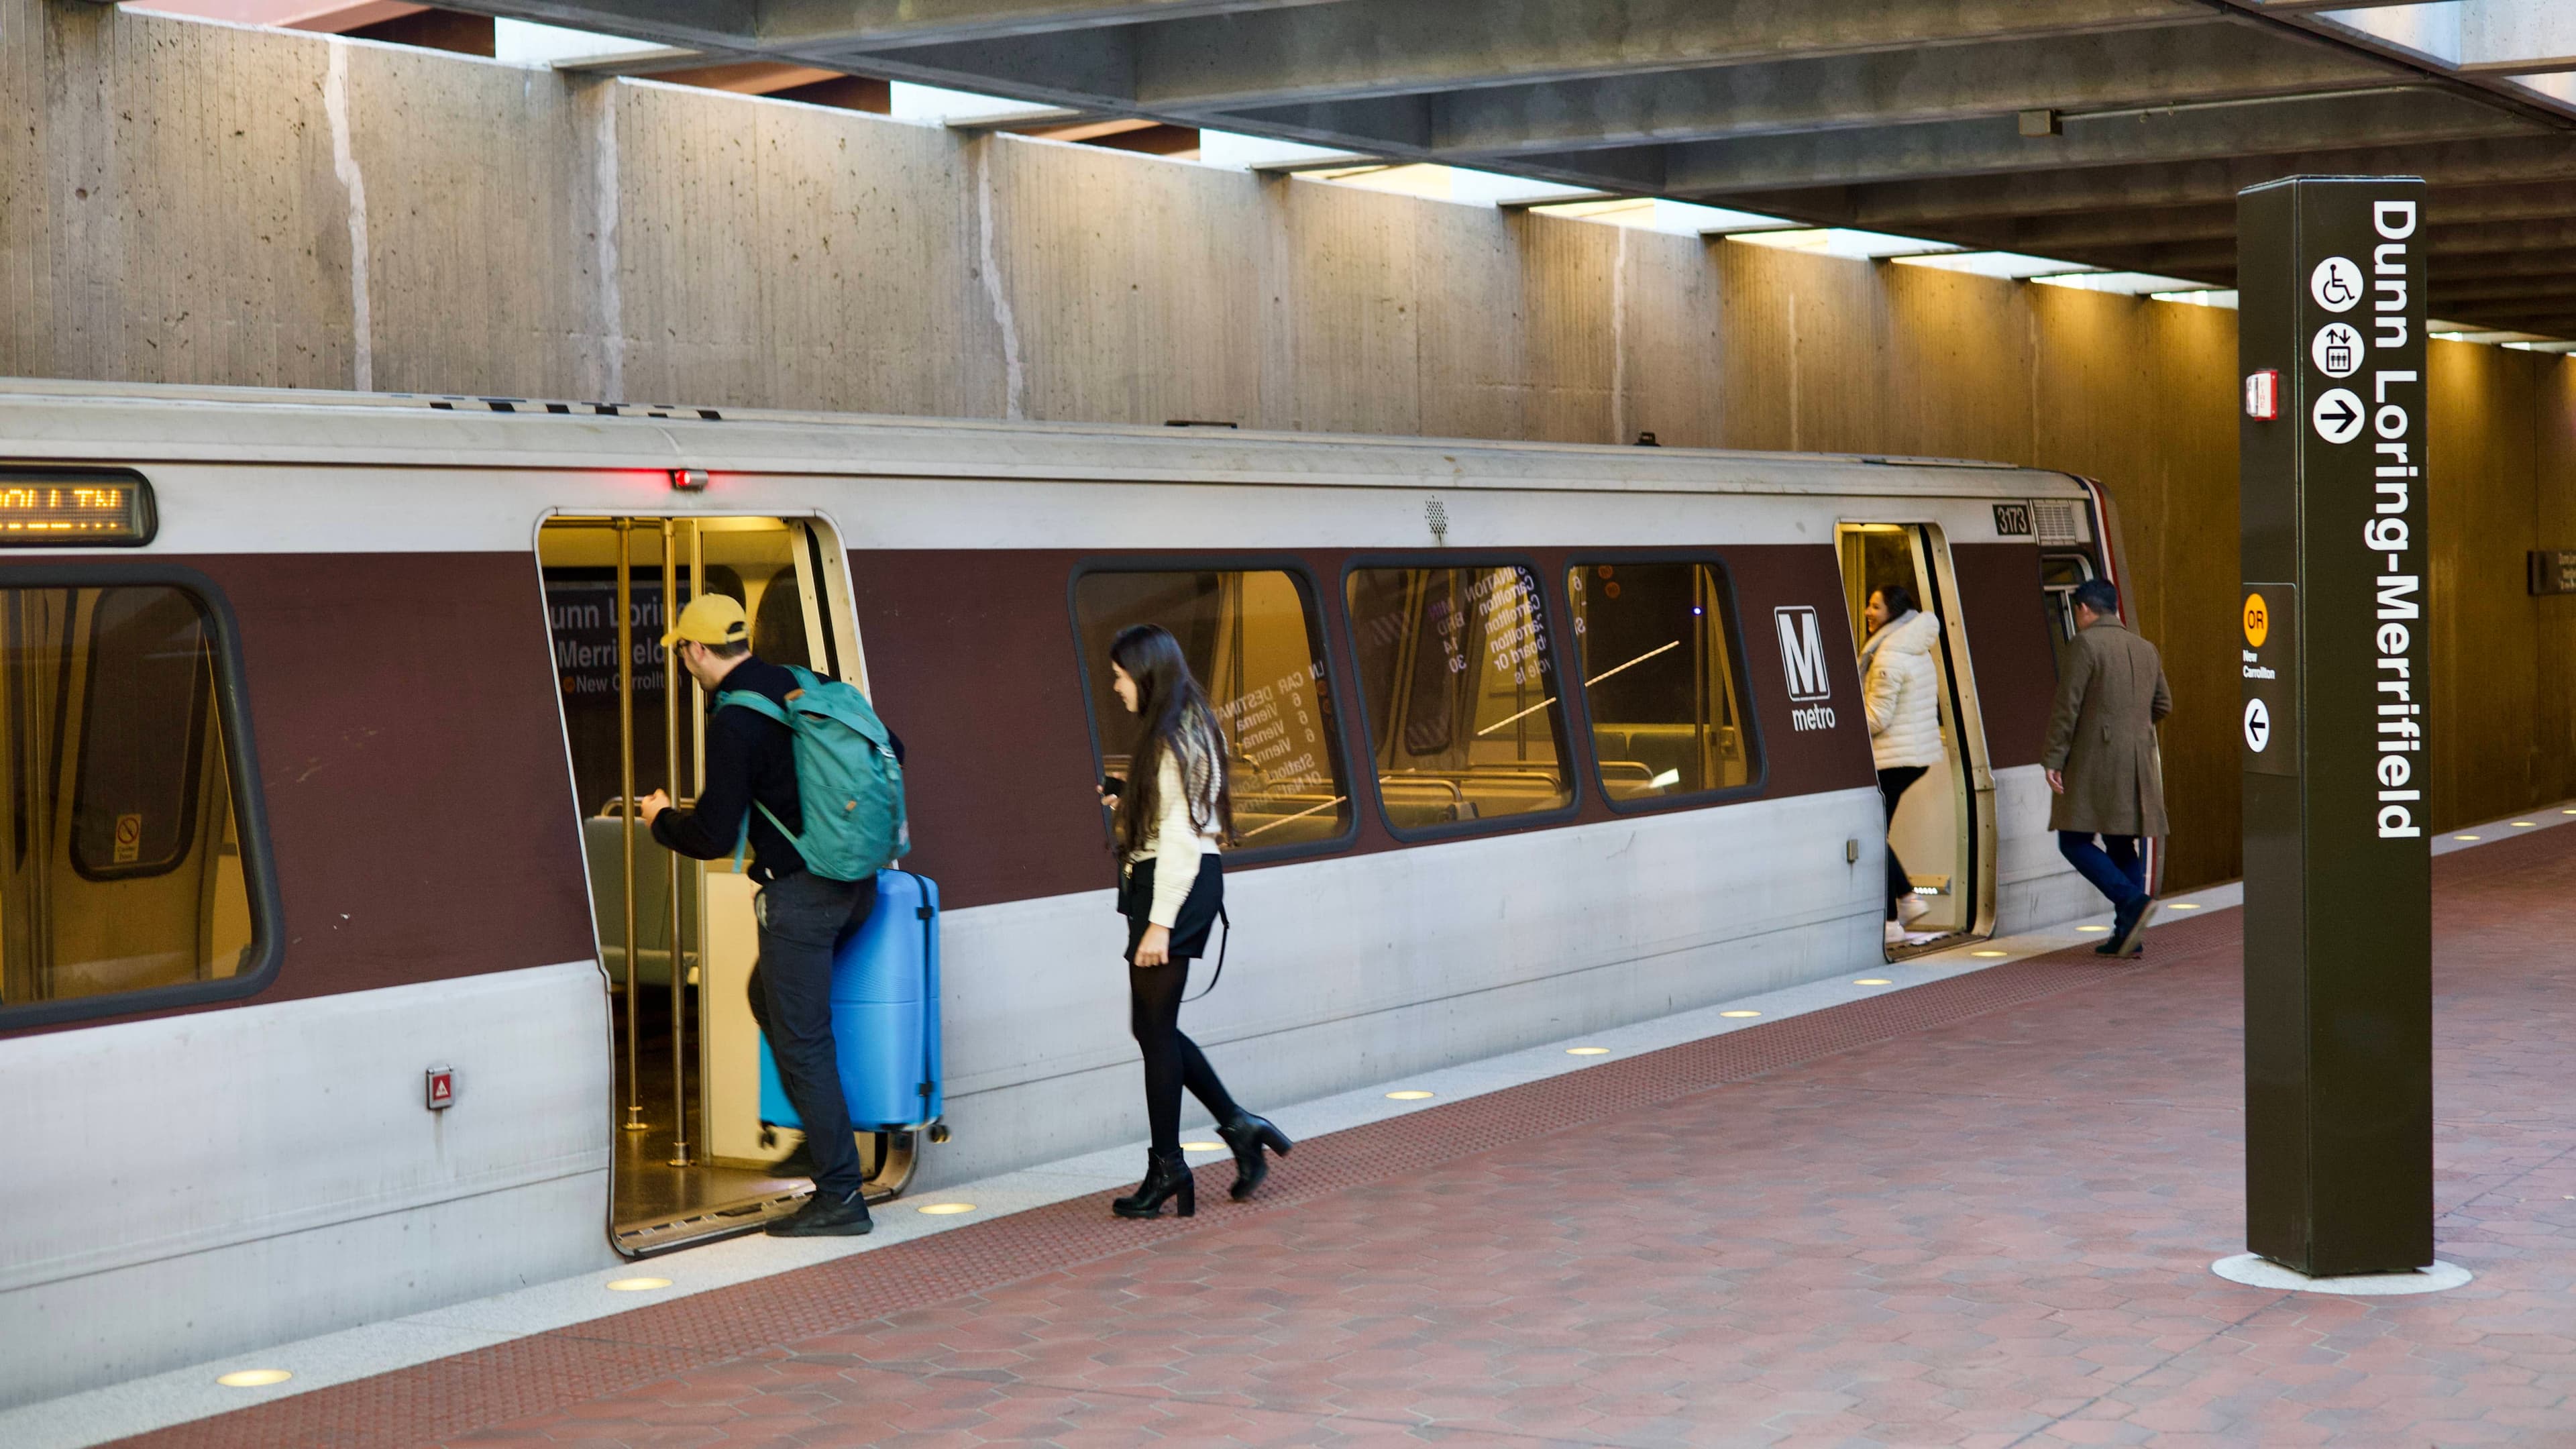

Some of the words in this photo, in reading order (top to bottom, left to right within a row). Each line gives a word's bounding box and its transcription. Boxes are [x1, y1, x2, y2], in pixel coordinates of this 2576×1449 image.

[2373, 201, 2416, 347] Dunn
[1997, 506, 2027, 534] 3173
[550, 604, 600, 630] unn
[2364, 370, 2421, 839] Loring-Merrifield
[2247, 610, 2265, 630] OR
[1778, 612, 1827, 695] M
[2243, 649, 2259, 663] New
[576, 675, 608, 693] New
[2243, 665, 2275, 680] Carrollton
[1792, 703, 1836, 732] metro
